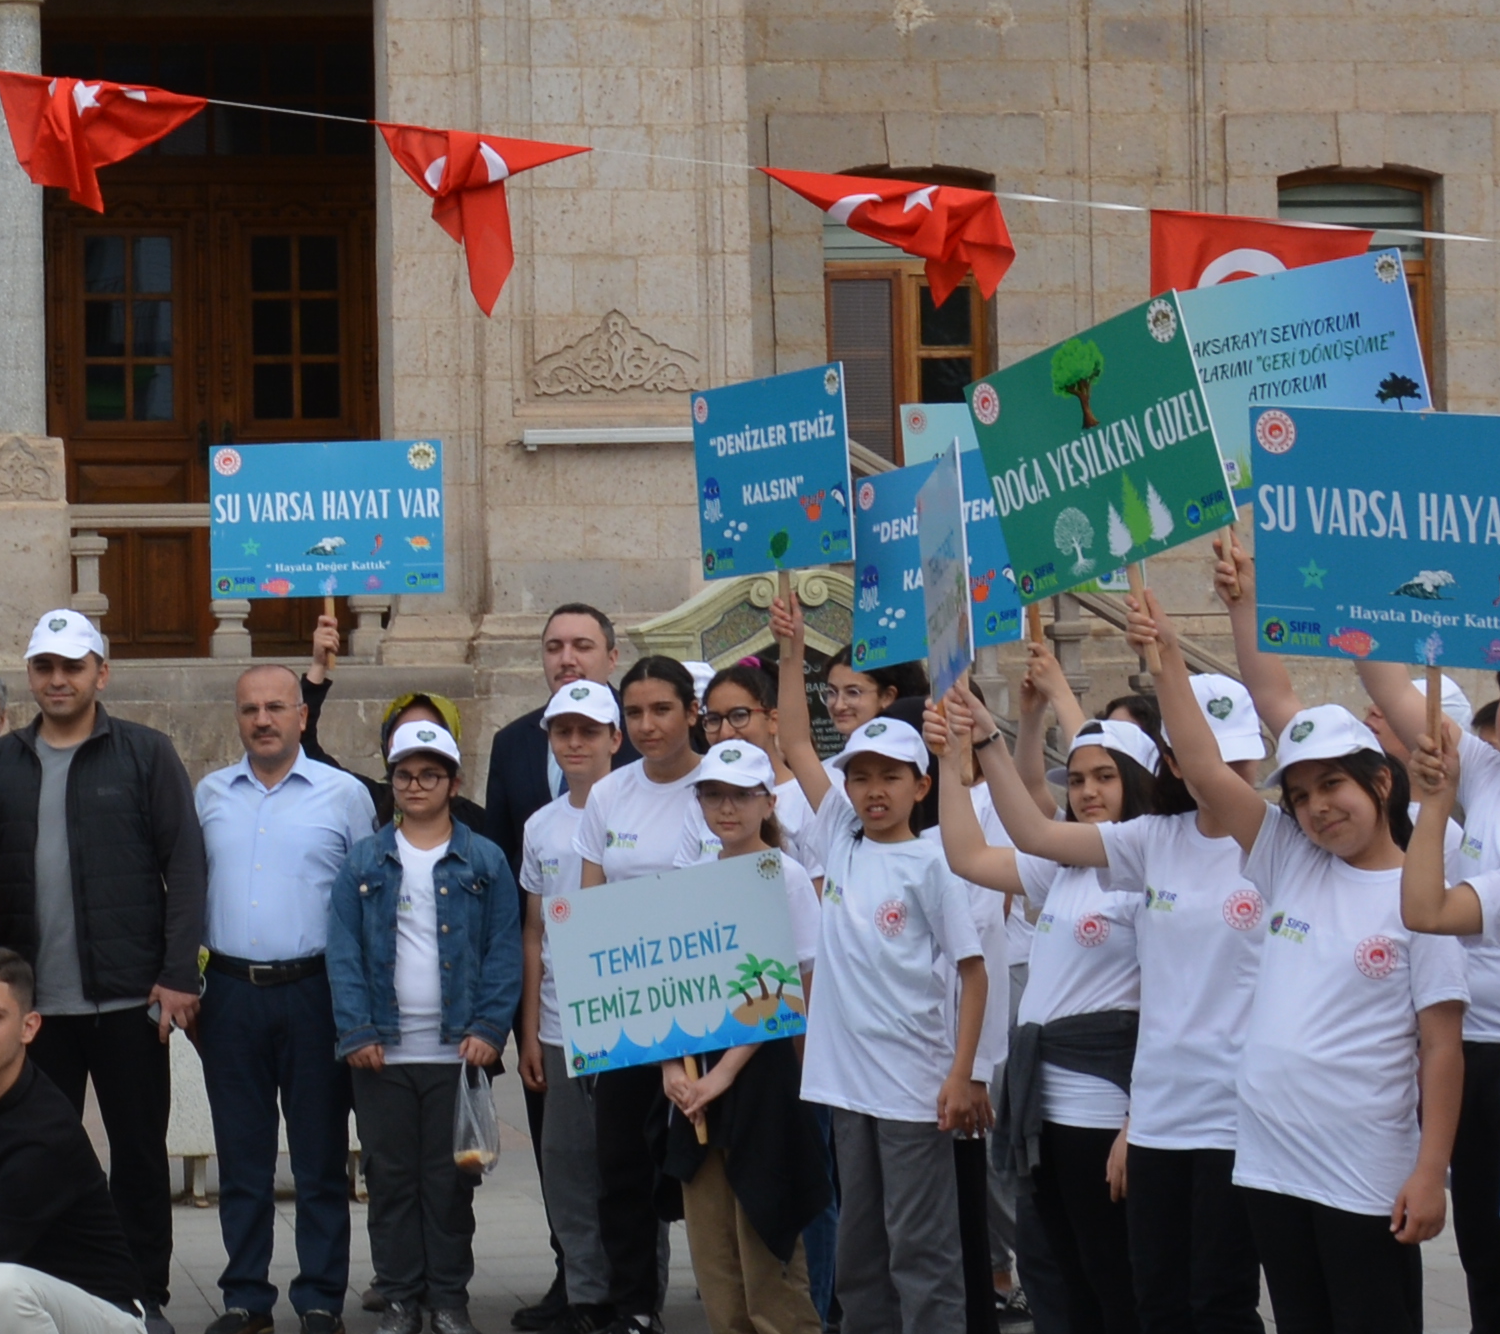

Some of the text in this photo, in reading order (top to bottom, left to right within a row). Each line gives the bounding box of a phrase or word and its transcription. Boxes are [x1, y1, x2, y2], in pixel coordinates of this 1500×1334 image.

[1270, 311, 1361, 343] SEVİYORUM
[1248, 372, 1328, 402] ATIYORUM
[789, 409, 836, 443] TEMİZ
[992, 389, 1209, 517] DOĞA YEŞİLKEN GÜZEL
[214, 487, 440, 524] SU VARSA HAYAT VAR
[1258, 484, 1297, 533] SU
[1306, 486, 1408, 540] VARSA
[1289, 620, 1321, 635] SIFIR
[1410, 610, 1460, 629] Değer
[1289, 633, 1321, 648] ATIK
[589, 921, 739, 977] TEMİZ DENİZ
[567, 974, 722, 1027] TEMİZ DÜNYA
